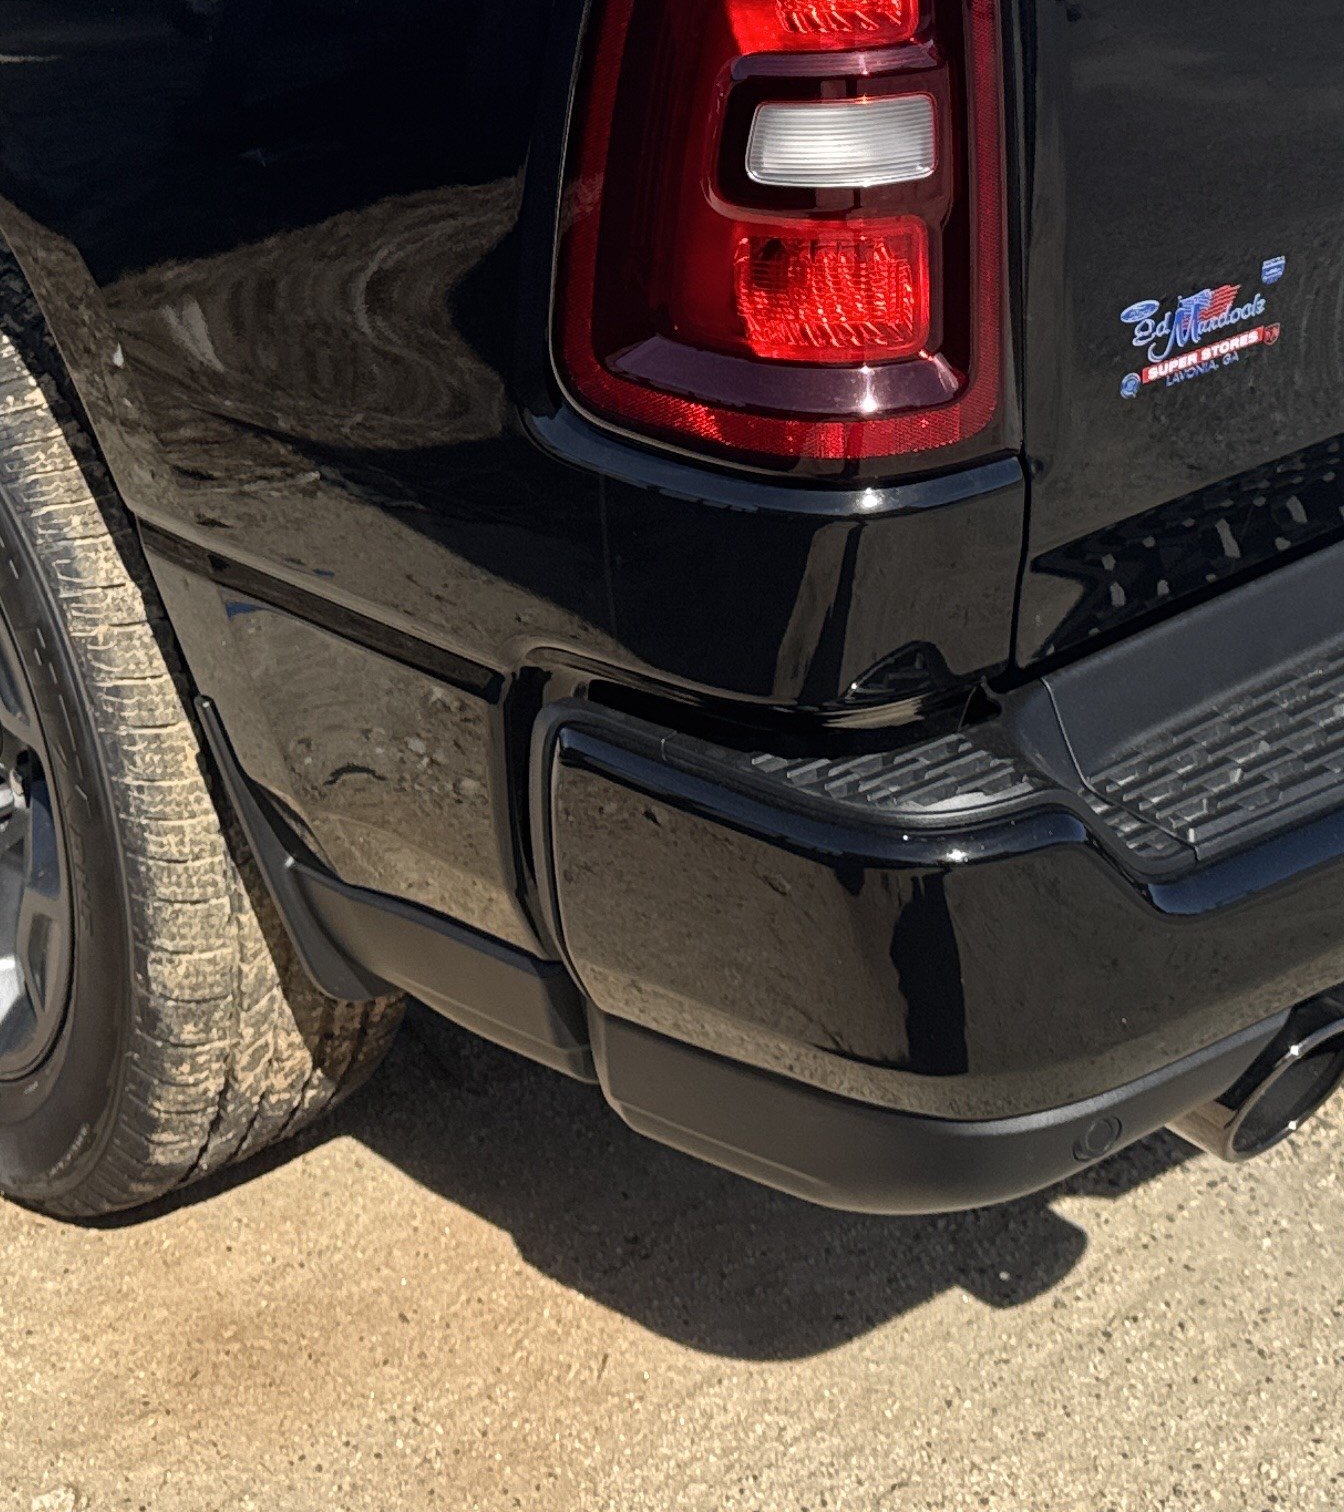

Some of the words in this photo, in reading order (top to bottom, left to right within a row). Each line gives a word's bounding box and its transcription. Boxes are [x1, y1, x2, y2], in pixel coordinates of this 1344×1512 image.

[1131, 311, 1172, 347] Ed
[1146, 351, 1199, 381] SUPER
[1199, 329, 1260, 362] STORES
